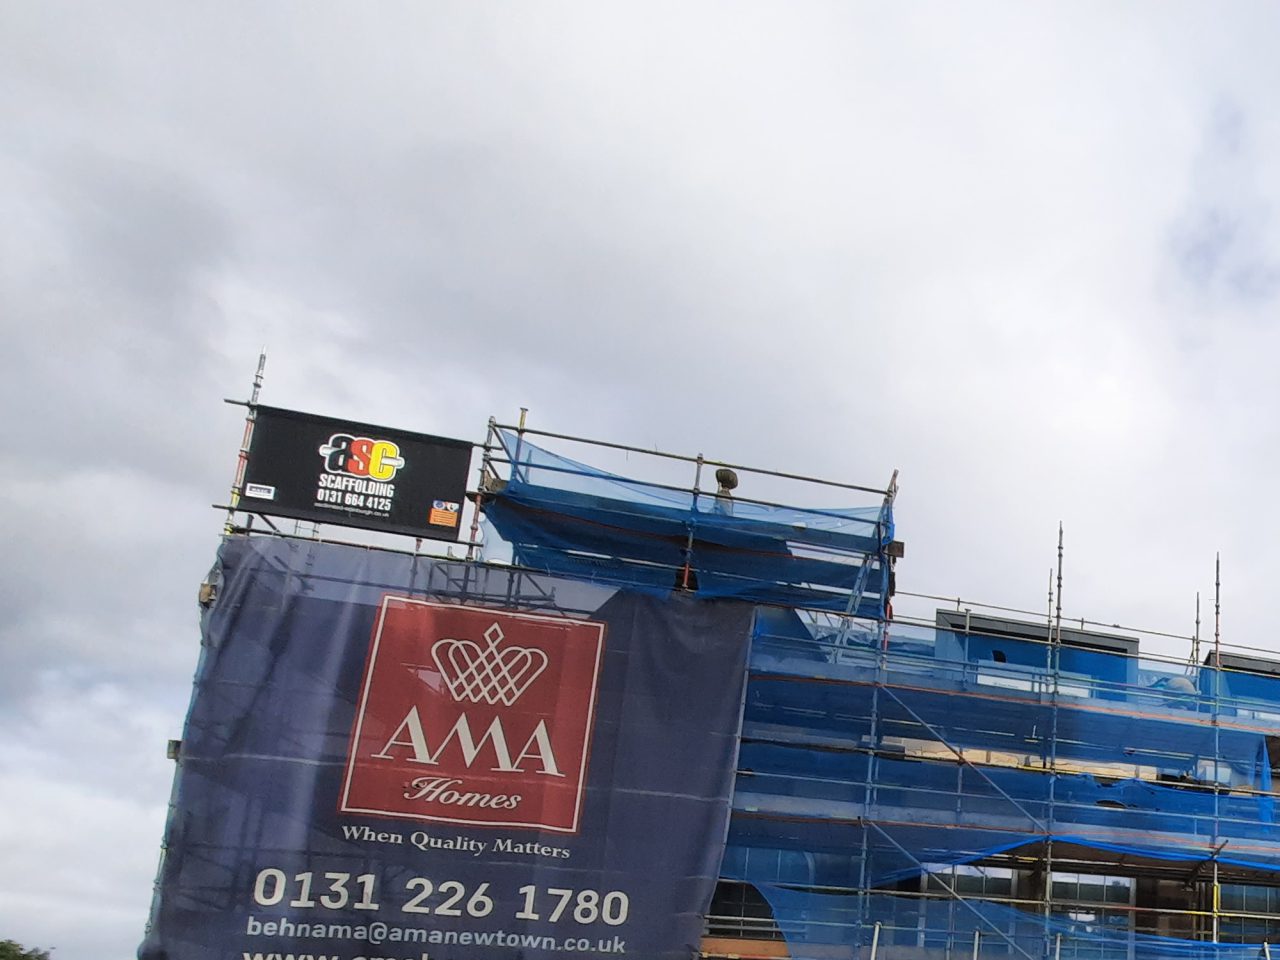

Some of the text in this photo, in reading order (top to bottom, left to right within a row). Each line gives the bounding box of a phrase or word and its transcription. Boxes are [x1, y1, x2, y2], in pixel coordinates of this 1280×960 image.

[317, 488, 392, 511] 0131 664 4125
[318, 473, 395, 498] SCAFFOLDING
[371, 705, 566, 777] AMA
[403, 776, 522, 810] Homes
[341, 825, 571, 859] When Quality Matters
[253, 868, 630, 926] 0131 226 1780
[245, 916, 627, 954] behnama@amanewtown.co.uk
